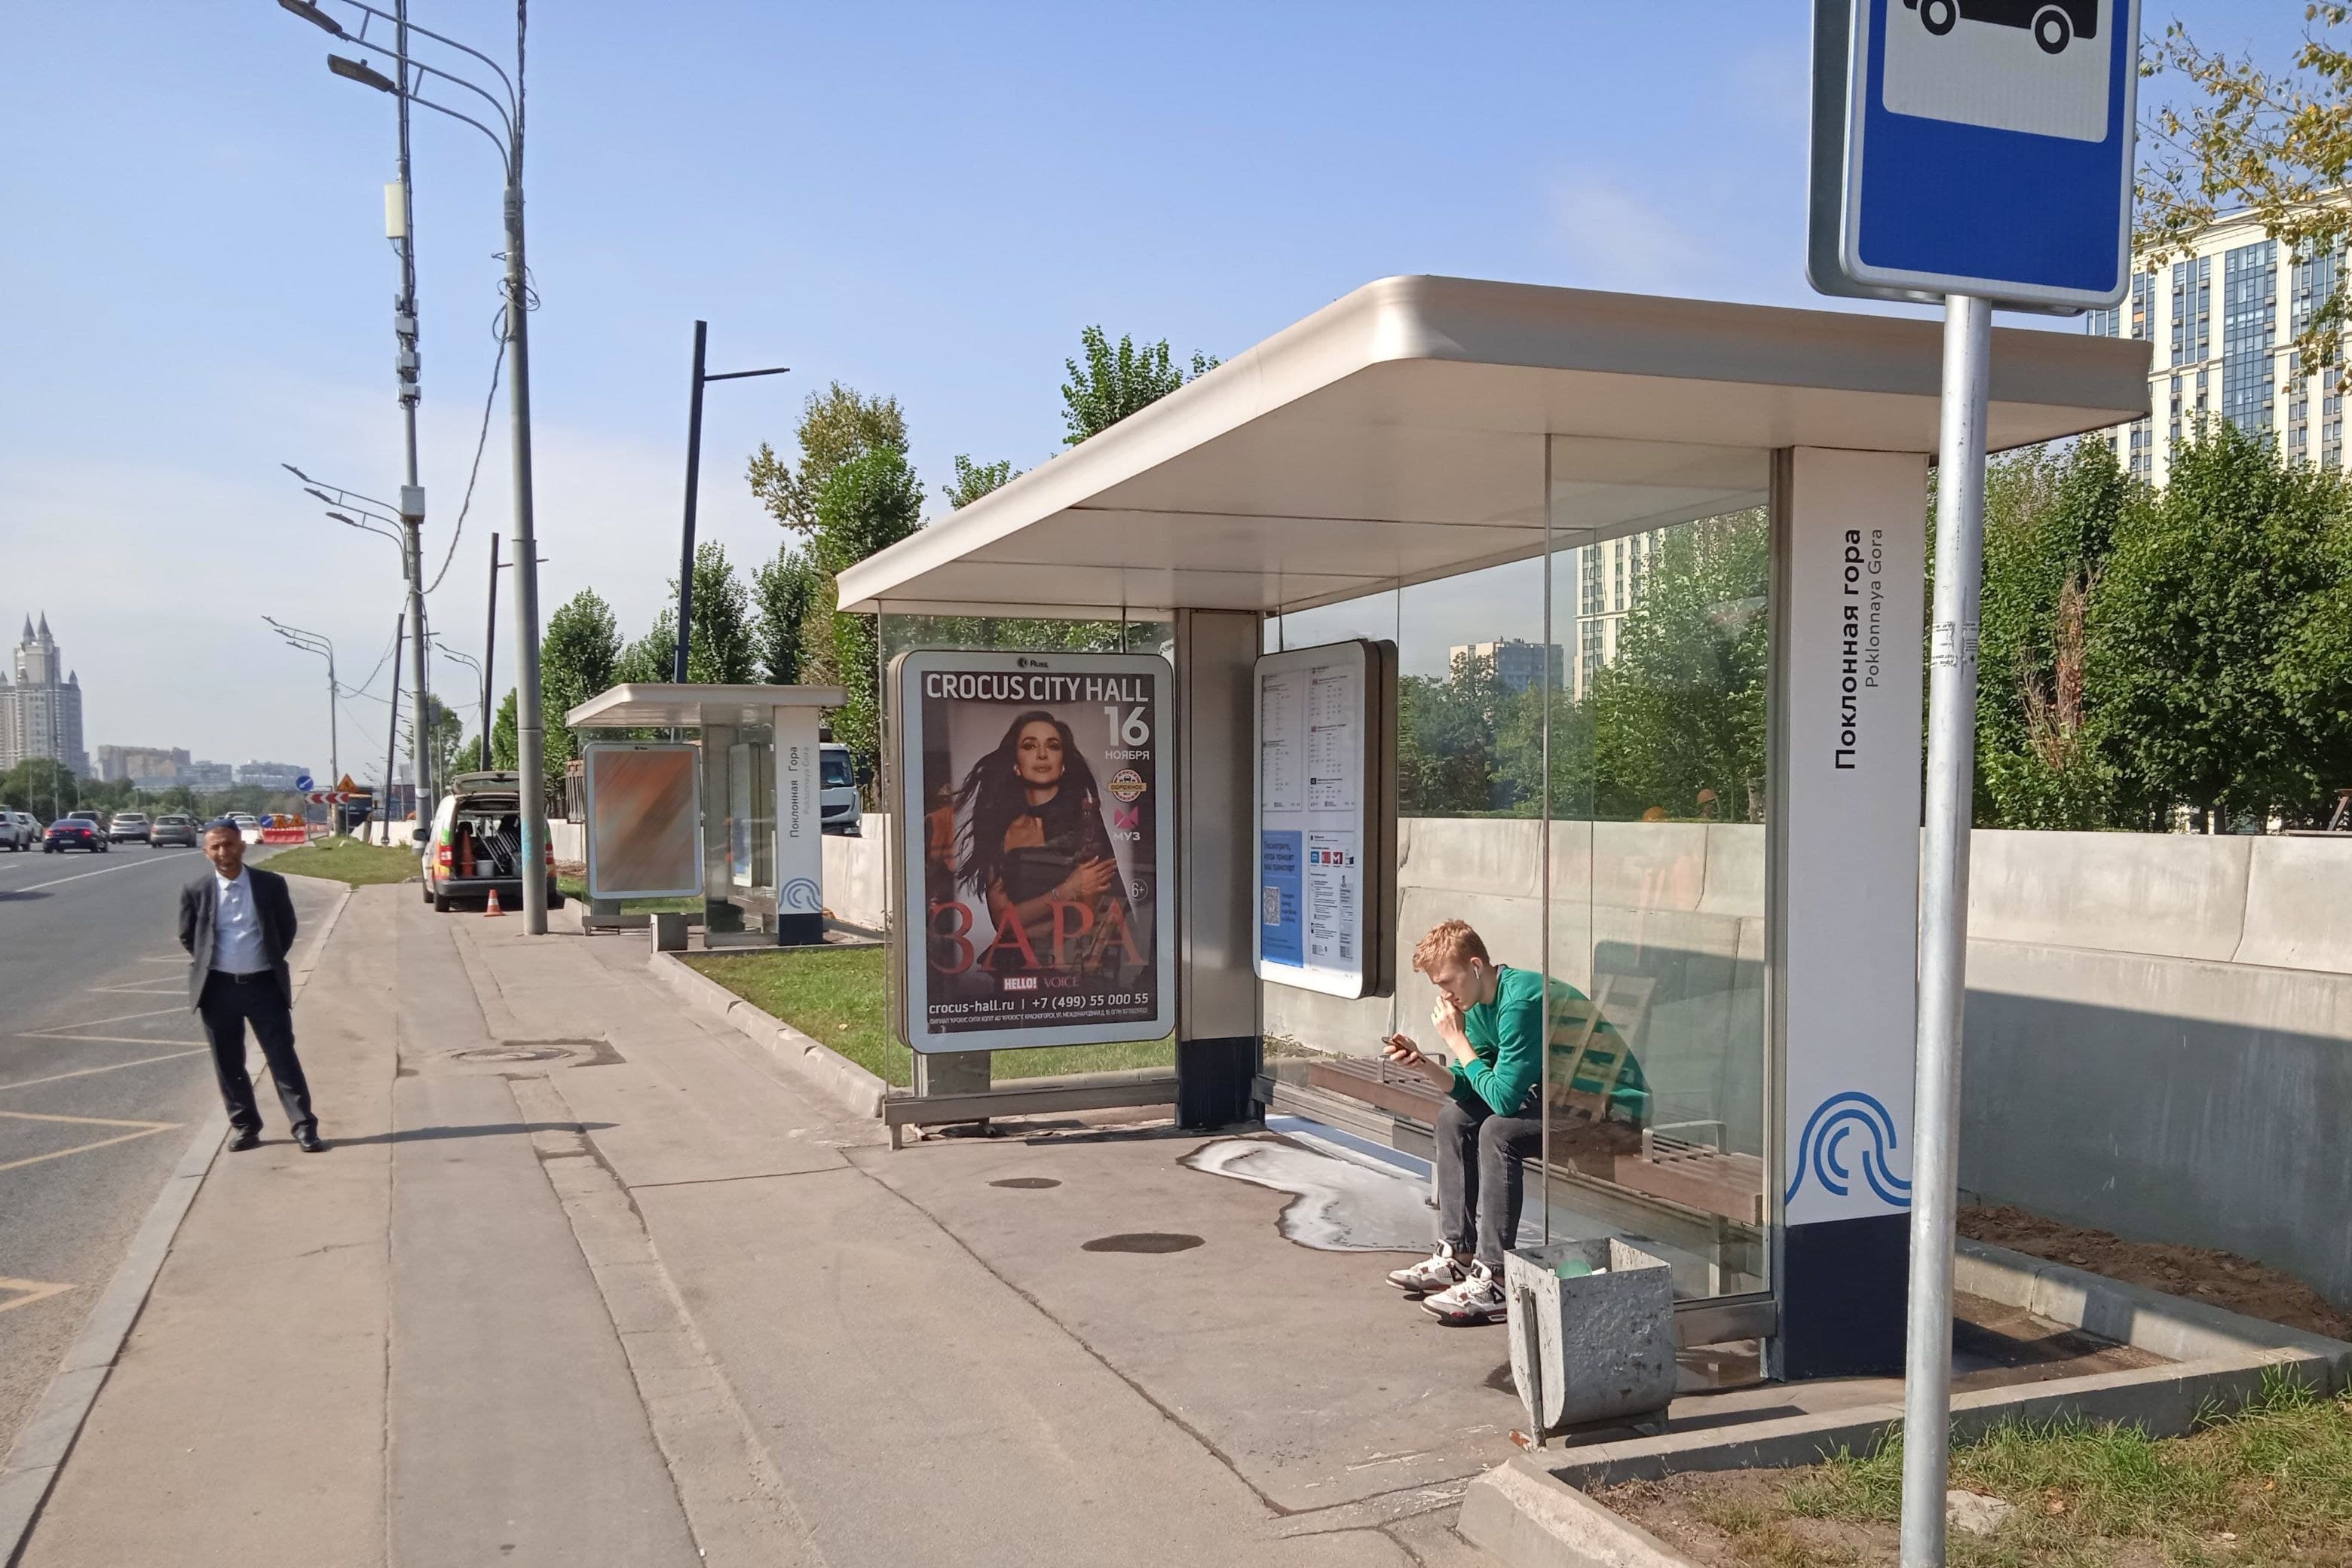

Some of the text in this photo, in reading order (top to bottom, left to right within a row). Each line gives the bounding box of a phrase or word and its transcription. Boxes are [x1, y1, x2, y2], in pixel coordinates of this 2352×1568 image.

[1865, 529, 1885, 688] Poklonnaya Gora
[1835, 529, 1864, 770] Поклонная гора
[926, 673, 1149, 703] CROCUS CITY HALL
[1104, 706, 1150, 746] 16
[1105, 750, 1150, 760] НОЯБРЯ
[789, 746, 799, 838] Поклонная Гора
[1113, 831, 1141, 841] МУЗ
[1132, 881, 1145, 898] 6+
[929, 899, 1145, 974] ЗАРА
[1003, 976, 1080, 990] HELLO! VOICE
[929, 993, 1149, 1014] crocus-hall.ru +7 (499) 55 000 55
